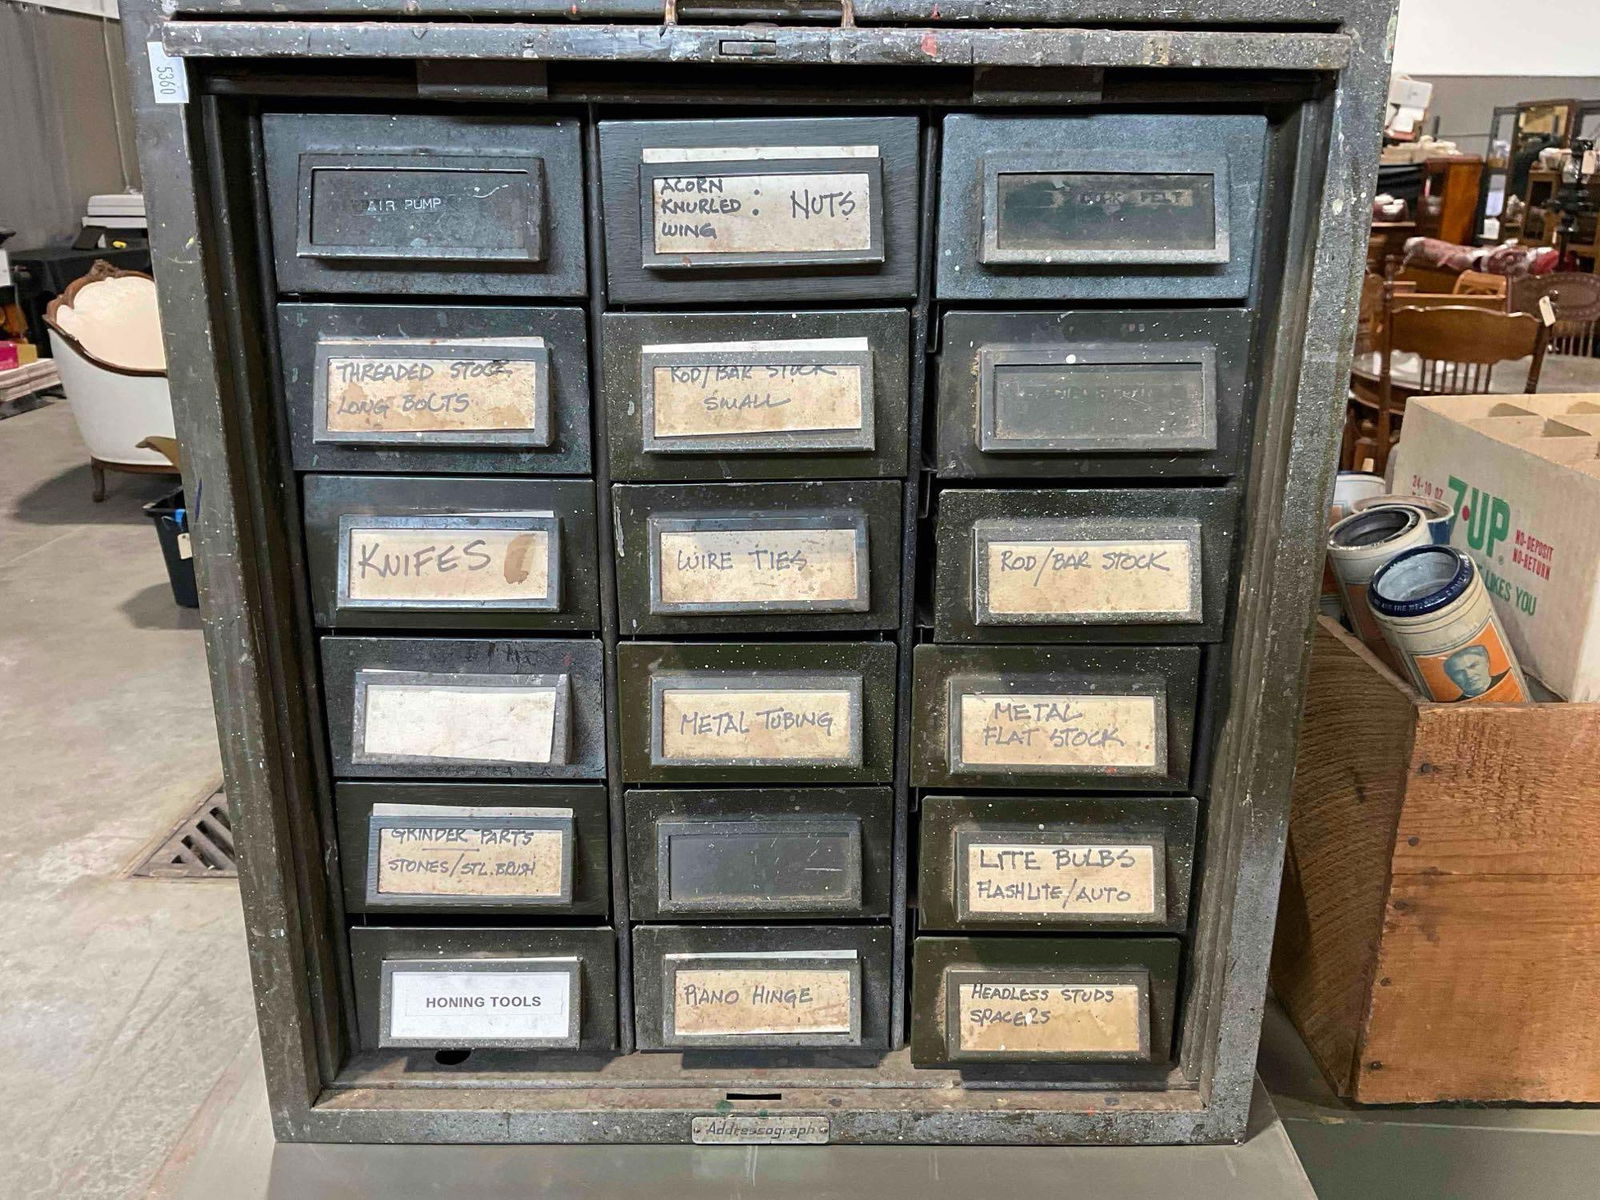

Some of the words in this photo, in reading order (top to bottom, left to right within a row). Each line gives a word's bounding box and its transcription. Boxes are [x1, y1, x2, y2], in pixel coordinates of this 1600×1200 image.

[156, 66, 176, 95] 5360
[660, 177, 723, 195] ACORN
[367, 201, 395, 212] AIR
[404, 198, 442, 210] PUMP
[660, 198, 742, 215] KNURLED
[790, 189, 856, 219] NUTS
[661, 222, 718, 240] WING
[336, 362, 435, 383] THREADED
[670, 366, 752, 389] ROD/BAR
[765, 365, 837, 379] STOCK
[337, 396, 390, 417] LONG
[401, 393, 470, 413] BOLTS
[704, 393, 791, 411] SMALL
[1514, 529, 1555, 562] NO-DEPOSIT
[358, 539, 492, 579] KNIFES
[677, 549, 733, 570] WIRE
[748, 549, 808, 571] TIES
[1001, 547, 1091, 587] ROD/BAR
[1102, 551, 1170, 572] STOCK
[1512, 548, 1552, 581] NO-RETURN
[1485, 570, 1512, 602] LIKES
[1515, 586, 1537, 616] YOU
[680, 710, 750, 736] METAL
[755, 706, 833, 736] TUBING
[994, 702, 1083, 722] METAL
[983, 725, 1039, 746] FLAT
[1049, 726, 1125, 747] STOCK
[391, 828, 468, 844] GRINDER
[477, 829, 534, 847] PARTS
[980, 849, 1041, 870] LITE
[1052, 848, 1136, 870] BULBS
[426, 997, 485, 1008] HONING
[490, 996, 541, 1007] TOOLS
[684, 983, 740, 1005] PIANO
[752, 985, 813, 1008] HINGE
[971, 983, 1049, 1002] HEADLESS
[1060, 989, 1115, 1003] STUDS
[705, 1121, 816, 1139] Addressograph
